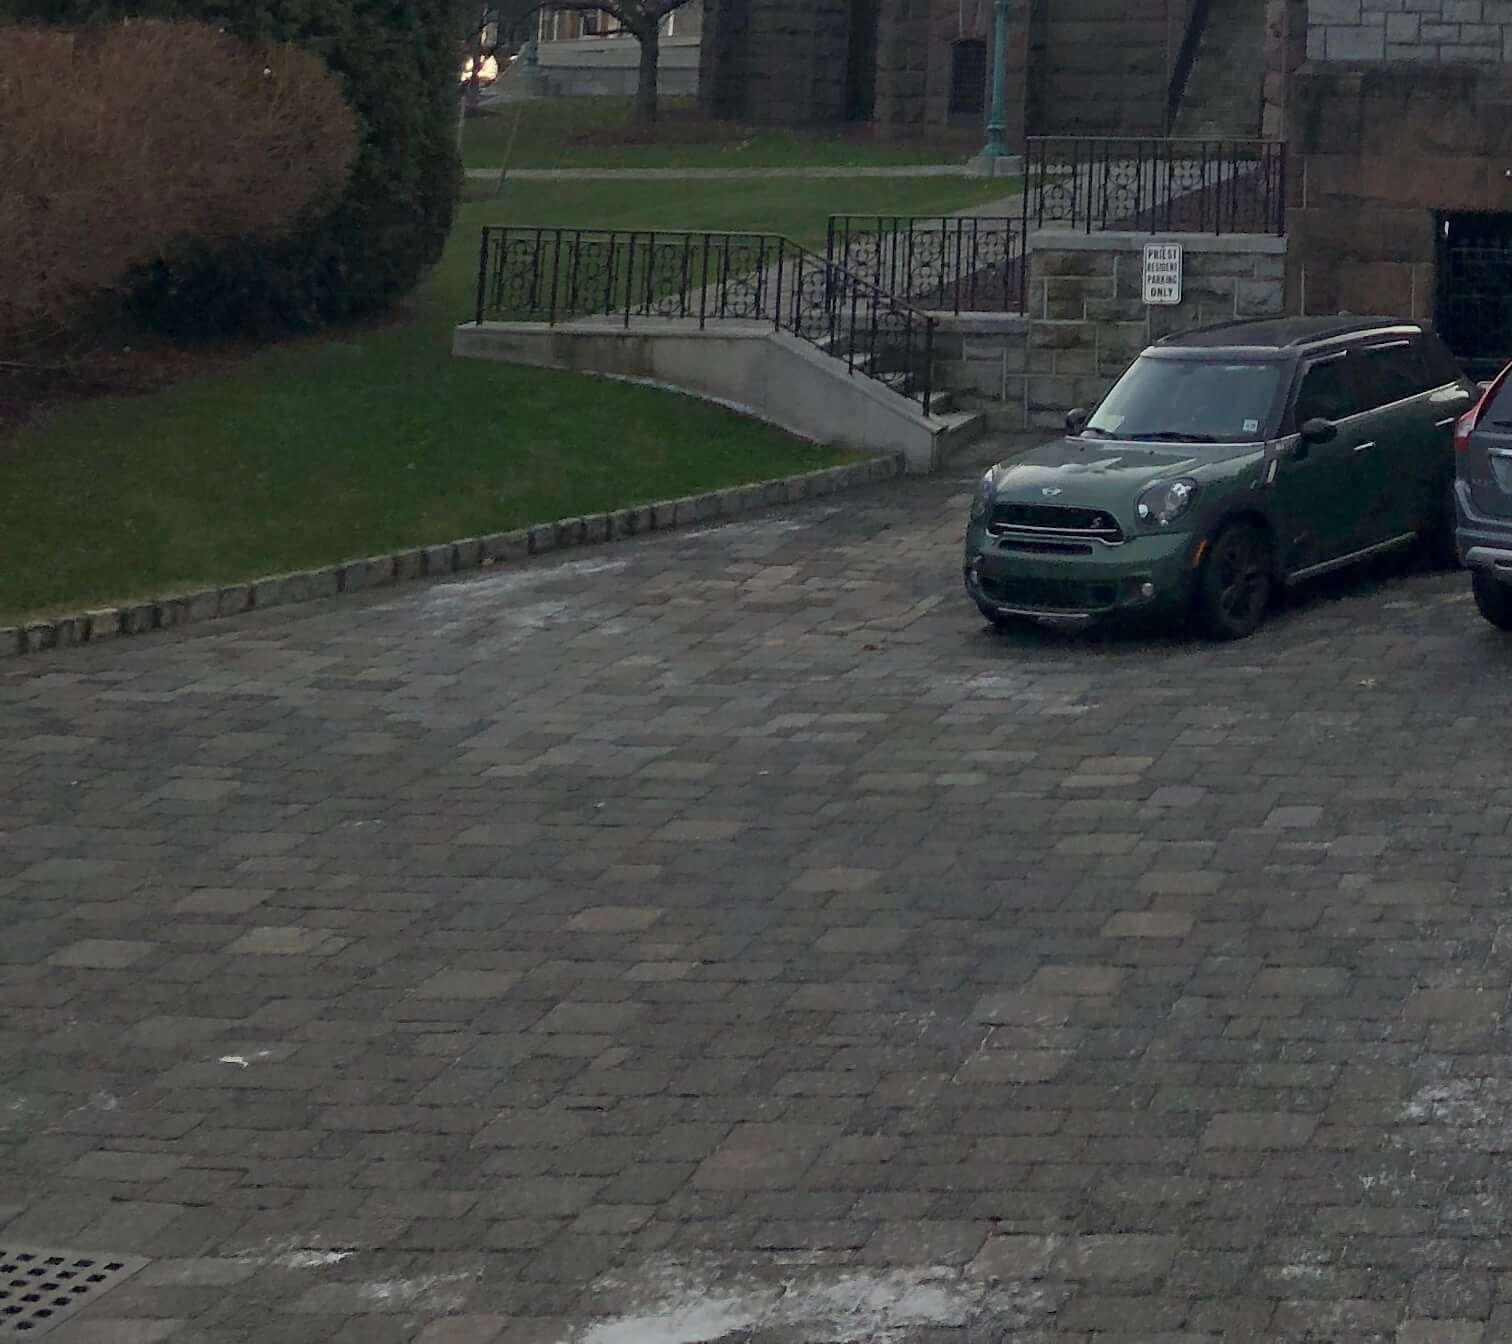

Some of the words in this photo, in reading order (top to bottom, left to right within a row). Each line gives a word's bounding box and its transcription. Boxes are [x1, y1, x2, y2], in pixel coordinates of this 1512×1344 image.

[1148, 248, 1177, 260] PRIEST
[1147, 262, 1178, 272] RESIDENT
[1147, 274, 1177, 284] PARKING
[1150, 287, 1173, 297] ONLY
